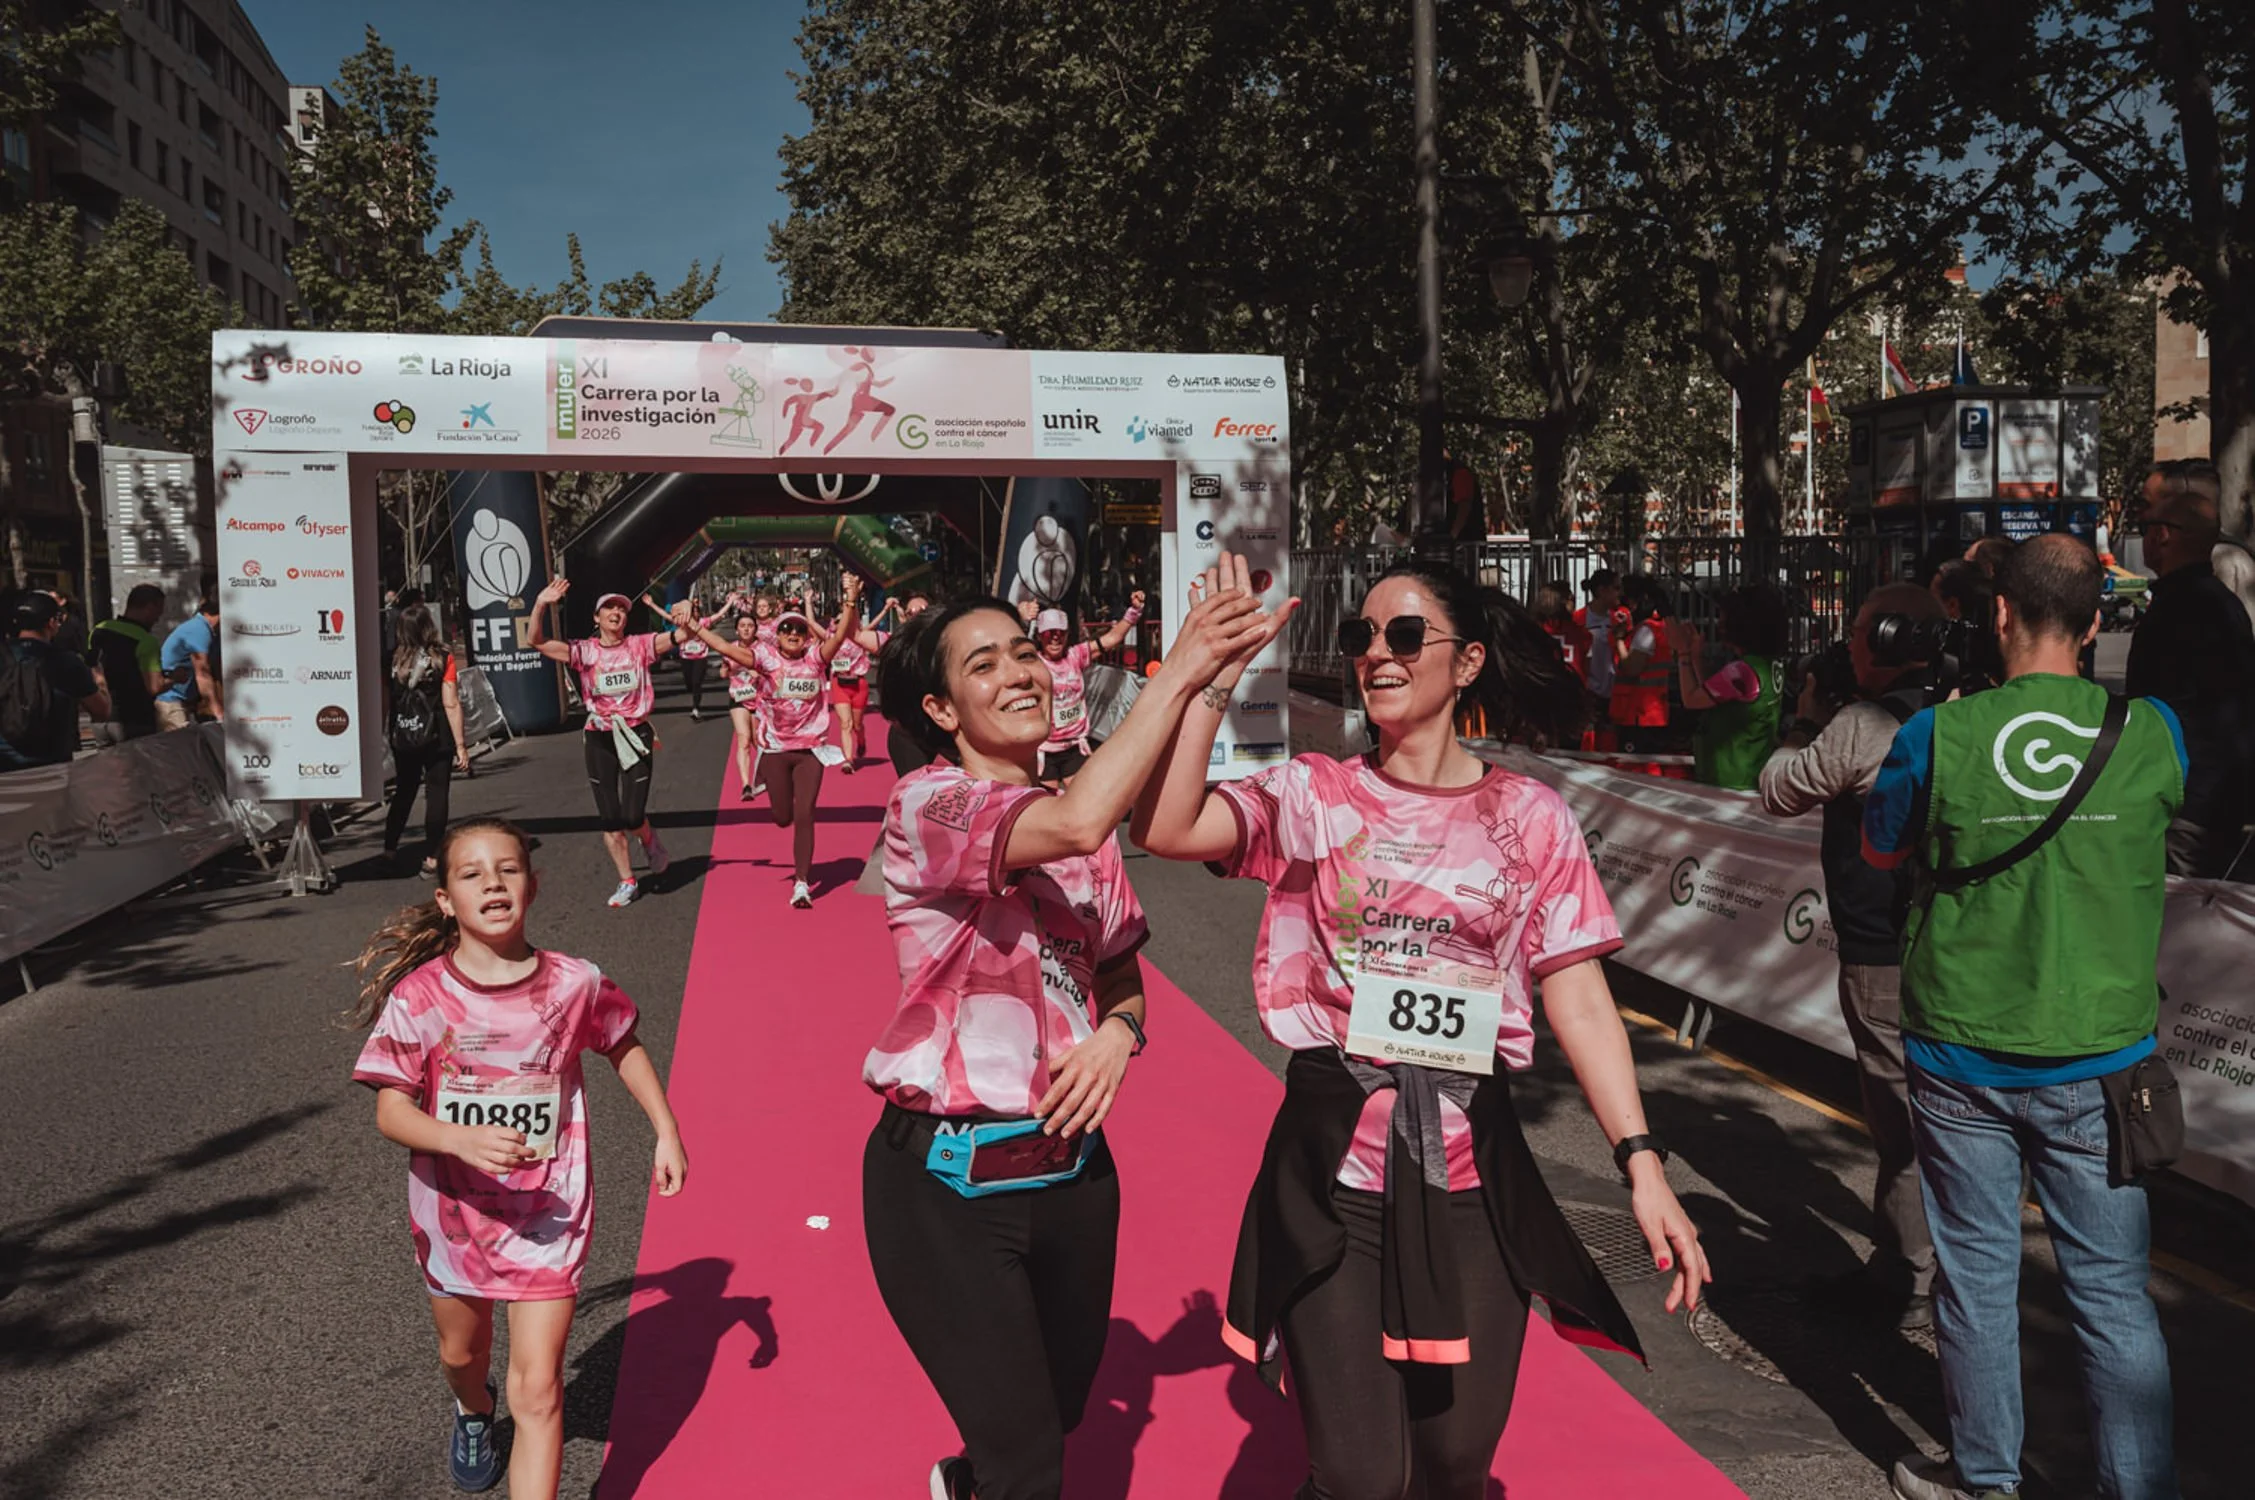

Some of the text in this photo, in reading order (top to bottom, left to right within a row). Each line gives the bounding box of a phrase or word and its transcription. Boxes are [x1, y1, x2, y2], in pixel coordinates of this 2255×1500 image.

[431, 358, 511, 379] La Rioja
[582, 357, 607, 378] XI
[1062, 374, 1117, 386] HUMILDAD
[1120, 376, 1144, 386] RUIZ
[1183, 377, 1261, 387] NATUR HOUSE
[555, 364, 576, 430] mujer
[581, 384, 720, 405] Carrera por la
[268, 414, 316, 426] Logroño
[581, 405, 716, 427] investigación
[934, 417, 1026, 428] asociación española
[1967, 411, 1980, 432] P
[437, 432, 481, 441] Fundación
[581, 427, 621, 440] 2026
[935, 429, 964, 437] contra
[976, 429, 1008, 437] cáncer
[1148, 423, 1193, 437] viamed
[962, 440, 985, 449] Rioja
[2001, 511, 2040, 520] ESCANEA
[226, 519, 286, 534] Alcampo
[301, 569, 345, 578] VIVAGYM
[494, 663, 502, 671] el
[605, 673, 631, 687] 8178
[788, 680, 815, 692] 6486
[243, 755, 271, 769] 100
[298, 762, 339, 776] tacto
[1364, 876, 1388, 899] XI
[1700, 883, 1763, 910] contra el cáncer
[1697, 899, 1705, 909] en
[1707, 900, 1717, 912] La
[1361, 905, 1451, 934] Carrera
[1361, 937, 1423, 958] por la
[1388, 988, 1466, 1040] 835
[2173, 1023, 2228, 1051] contra
[2230, 1037, 2247, 1057] el
[1396, 1047, 1426, 1057] NATUR
[460, 1065, 473, 1075] XI
[2165, 1046, 2255, 1087] en La Rioja
[445, 1101, 551, 1136] 10885
